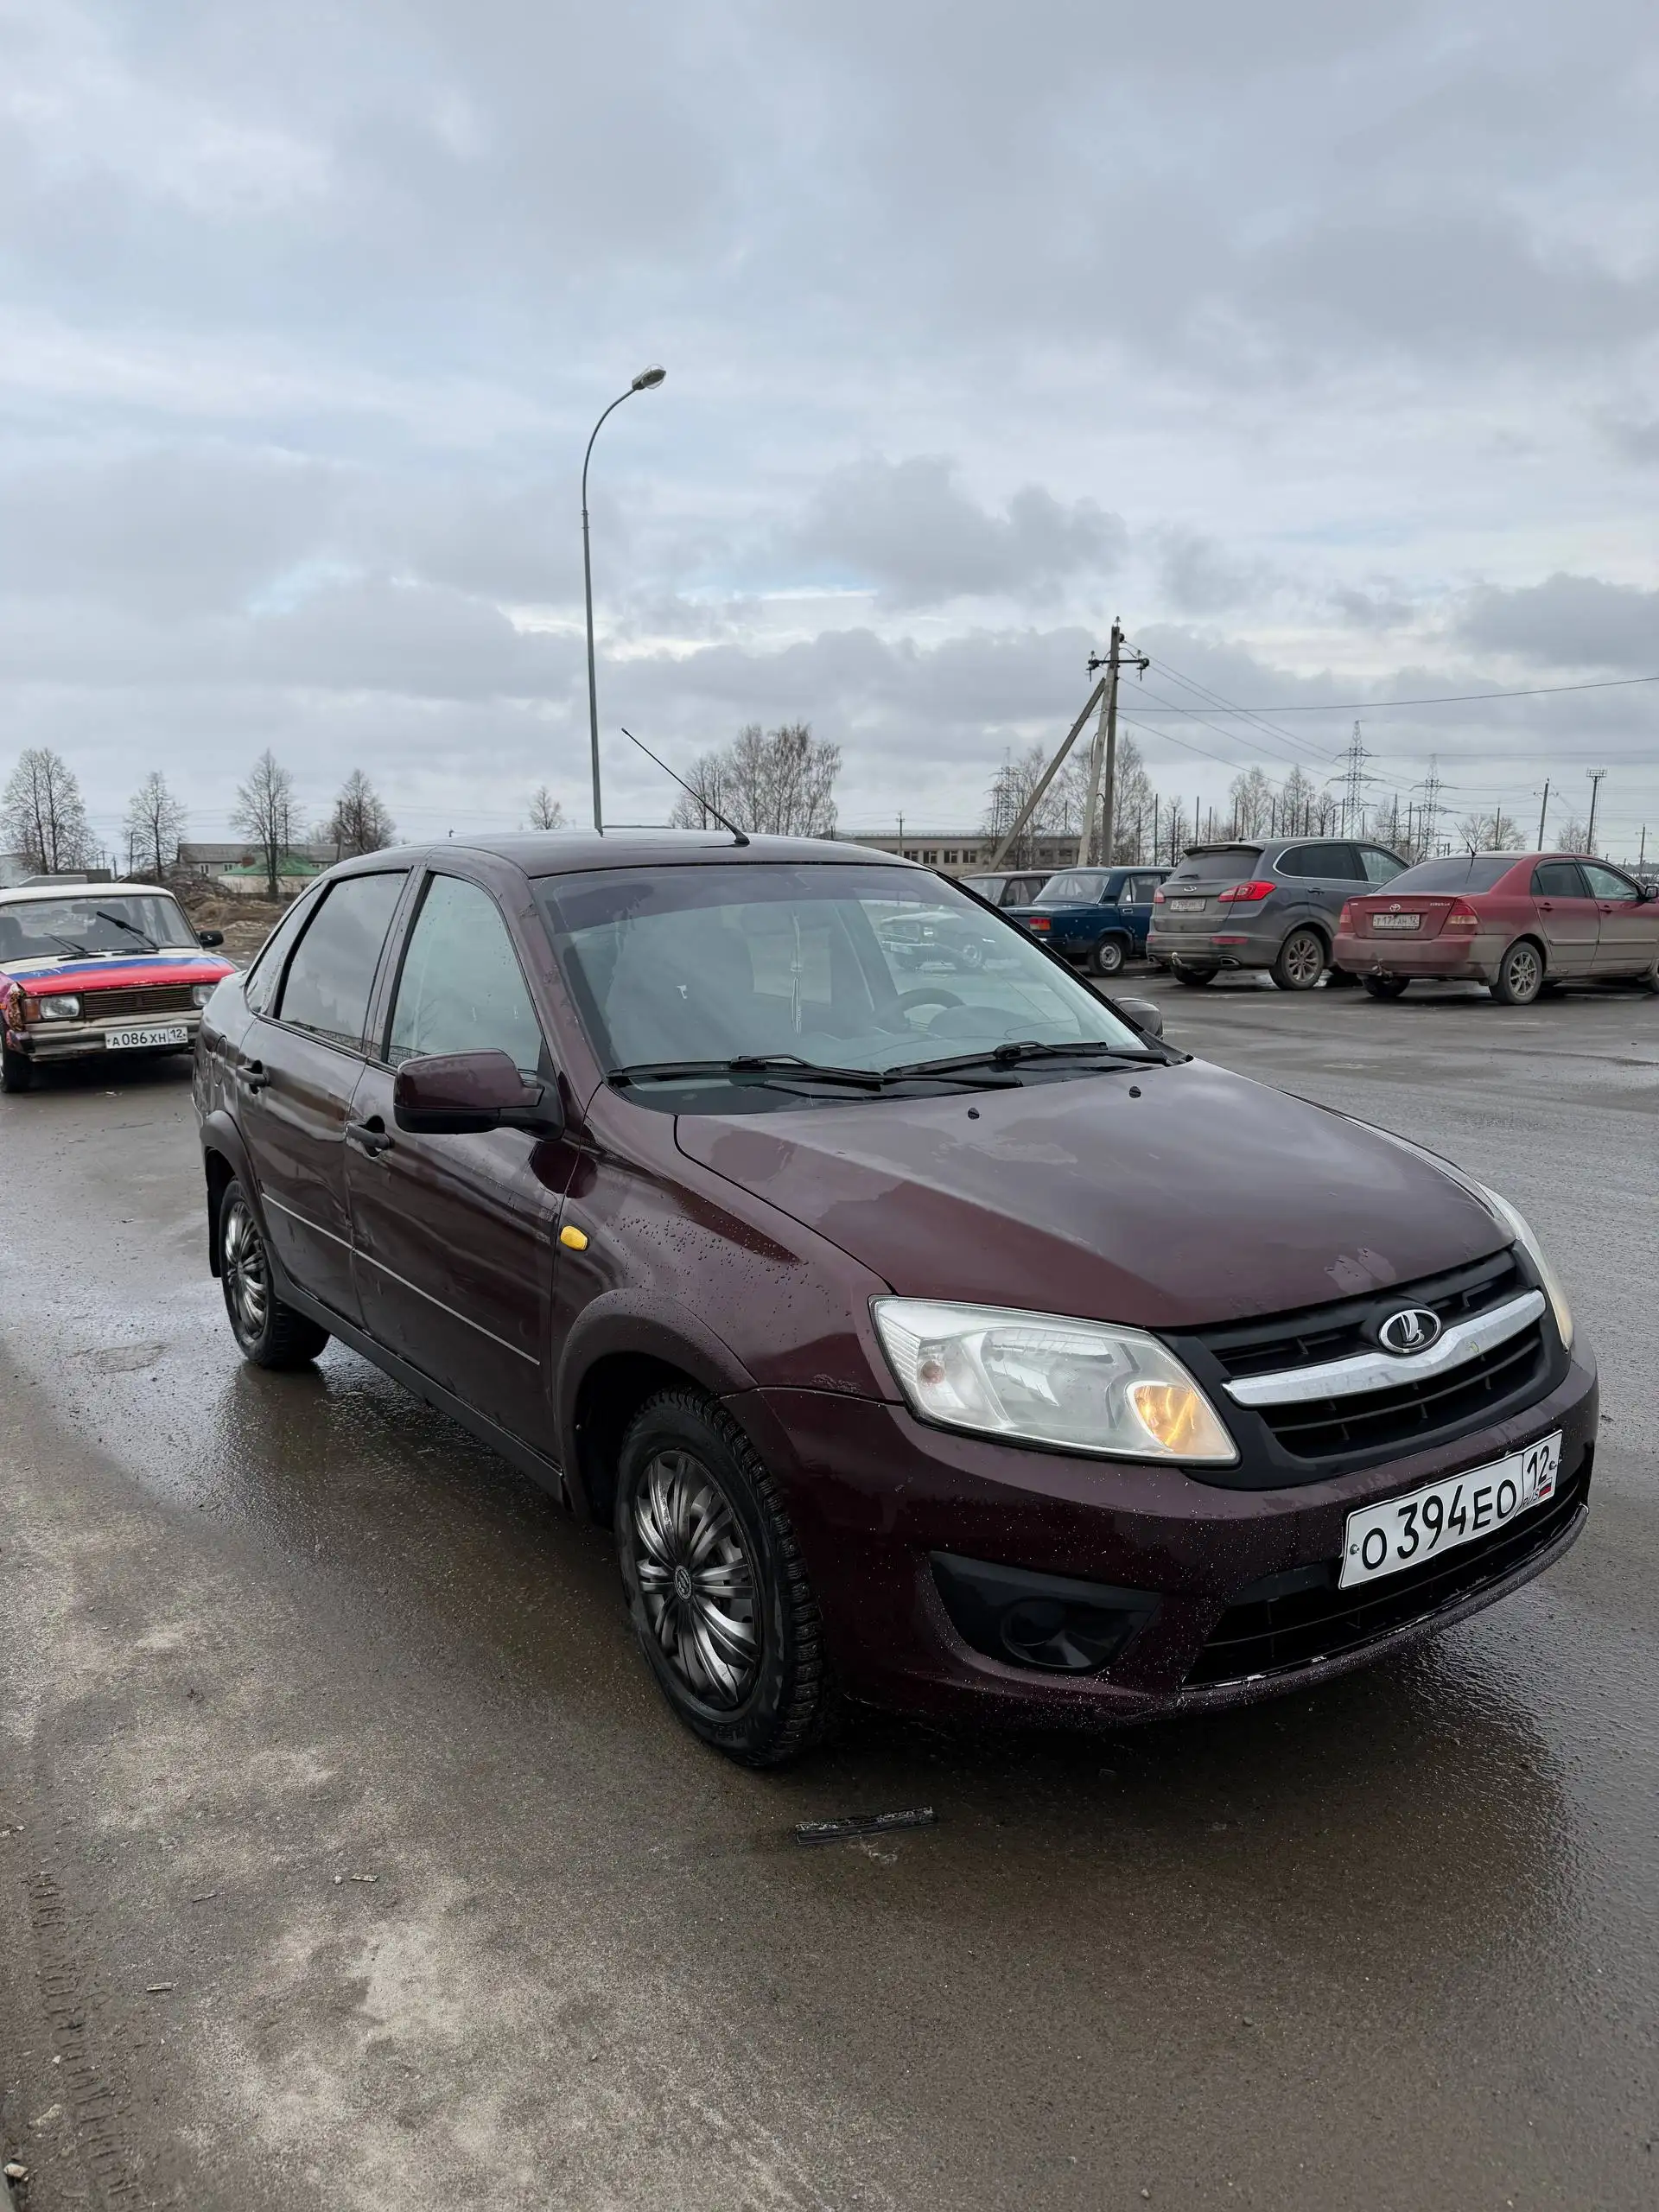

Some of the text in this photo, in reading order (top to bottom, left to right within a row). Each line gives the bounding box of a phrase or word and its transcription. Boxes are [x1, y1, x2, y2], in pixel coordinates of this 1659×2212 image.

[170, 1029, 182, 1039] 12
[1362, 1445, 1549, 1570] О394ЕО 12
